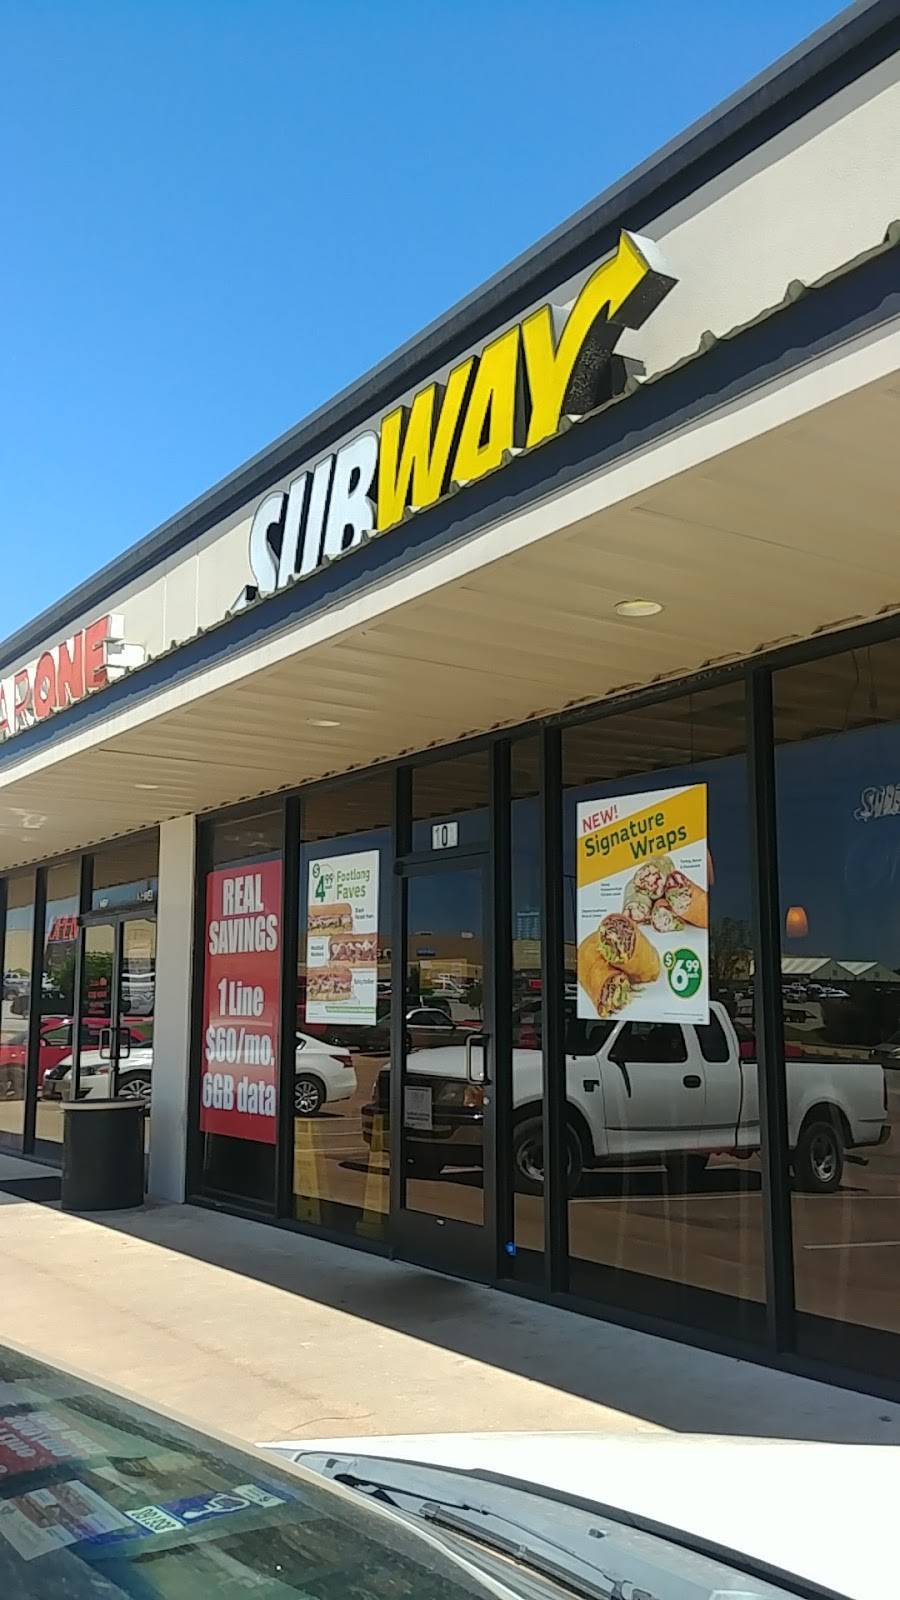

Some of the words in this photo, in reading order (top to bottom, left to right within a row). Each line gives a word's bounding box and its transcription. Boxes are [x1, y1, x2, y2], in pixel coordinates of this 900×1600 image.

[231, 229, 652, 613] SUBWAY
[582, 804, 618, 833] NEW!
[584, 812, 665, 857] Signature
[629, 825, 688, 860] Wraps
[222, 873, 264, 916] REAL
[336, 884, 366, 900] Faves
[209, 914, 278, 956] SAVINGS
[218, 977, 227, 1016] 1
[227, 980, 265, 1017] Line
[205, 1024, 275, 1067] $60/mo.
[202, 1072, 235, 1111] 6GB
[237, 1076, 276, 1117] data
